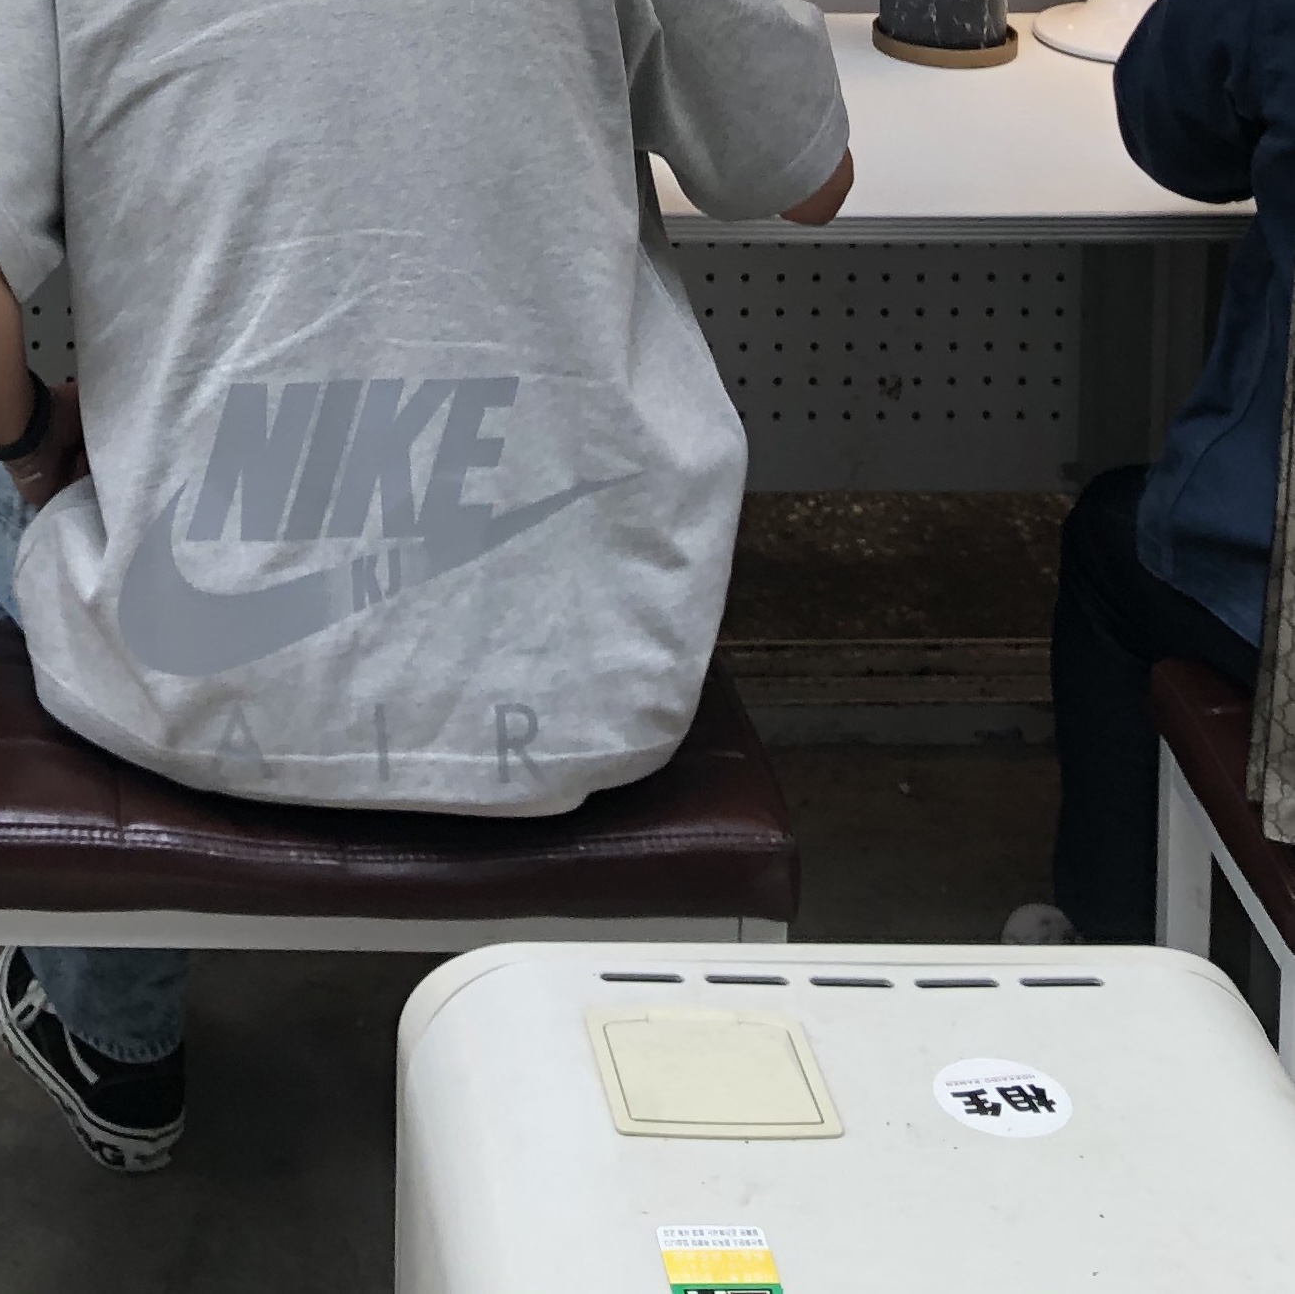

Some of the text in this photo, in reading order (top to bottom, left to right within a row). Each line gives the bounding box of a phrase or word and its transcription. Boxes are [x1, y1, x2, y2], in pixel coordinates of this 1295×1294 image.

[185, 375, 520, 543] NIKE
[210, 702, 547, 785] AIR
[949, 1084, 1057, 1118] 相生
